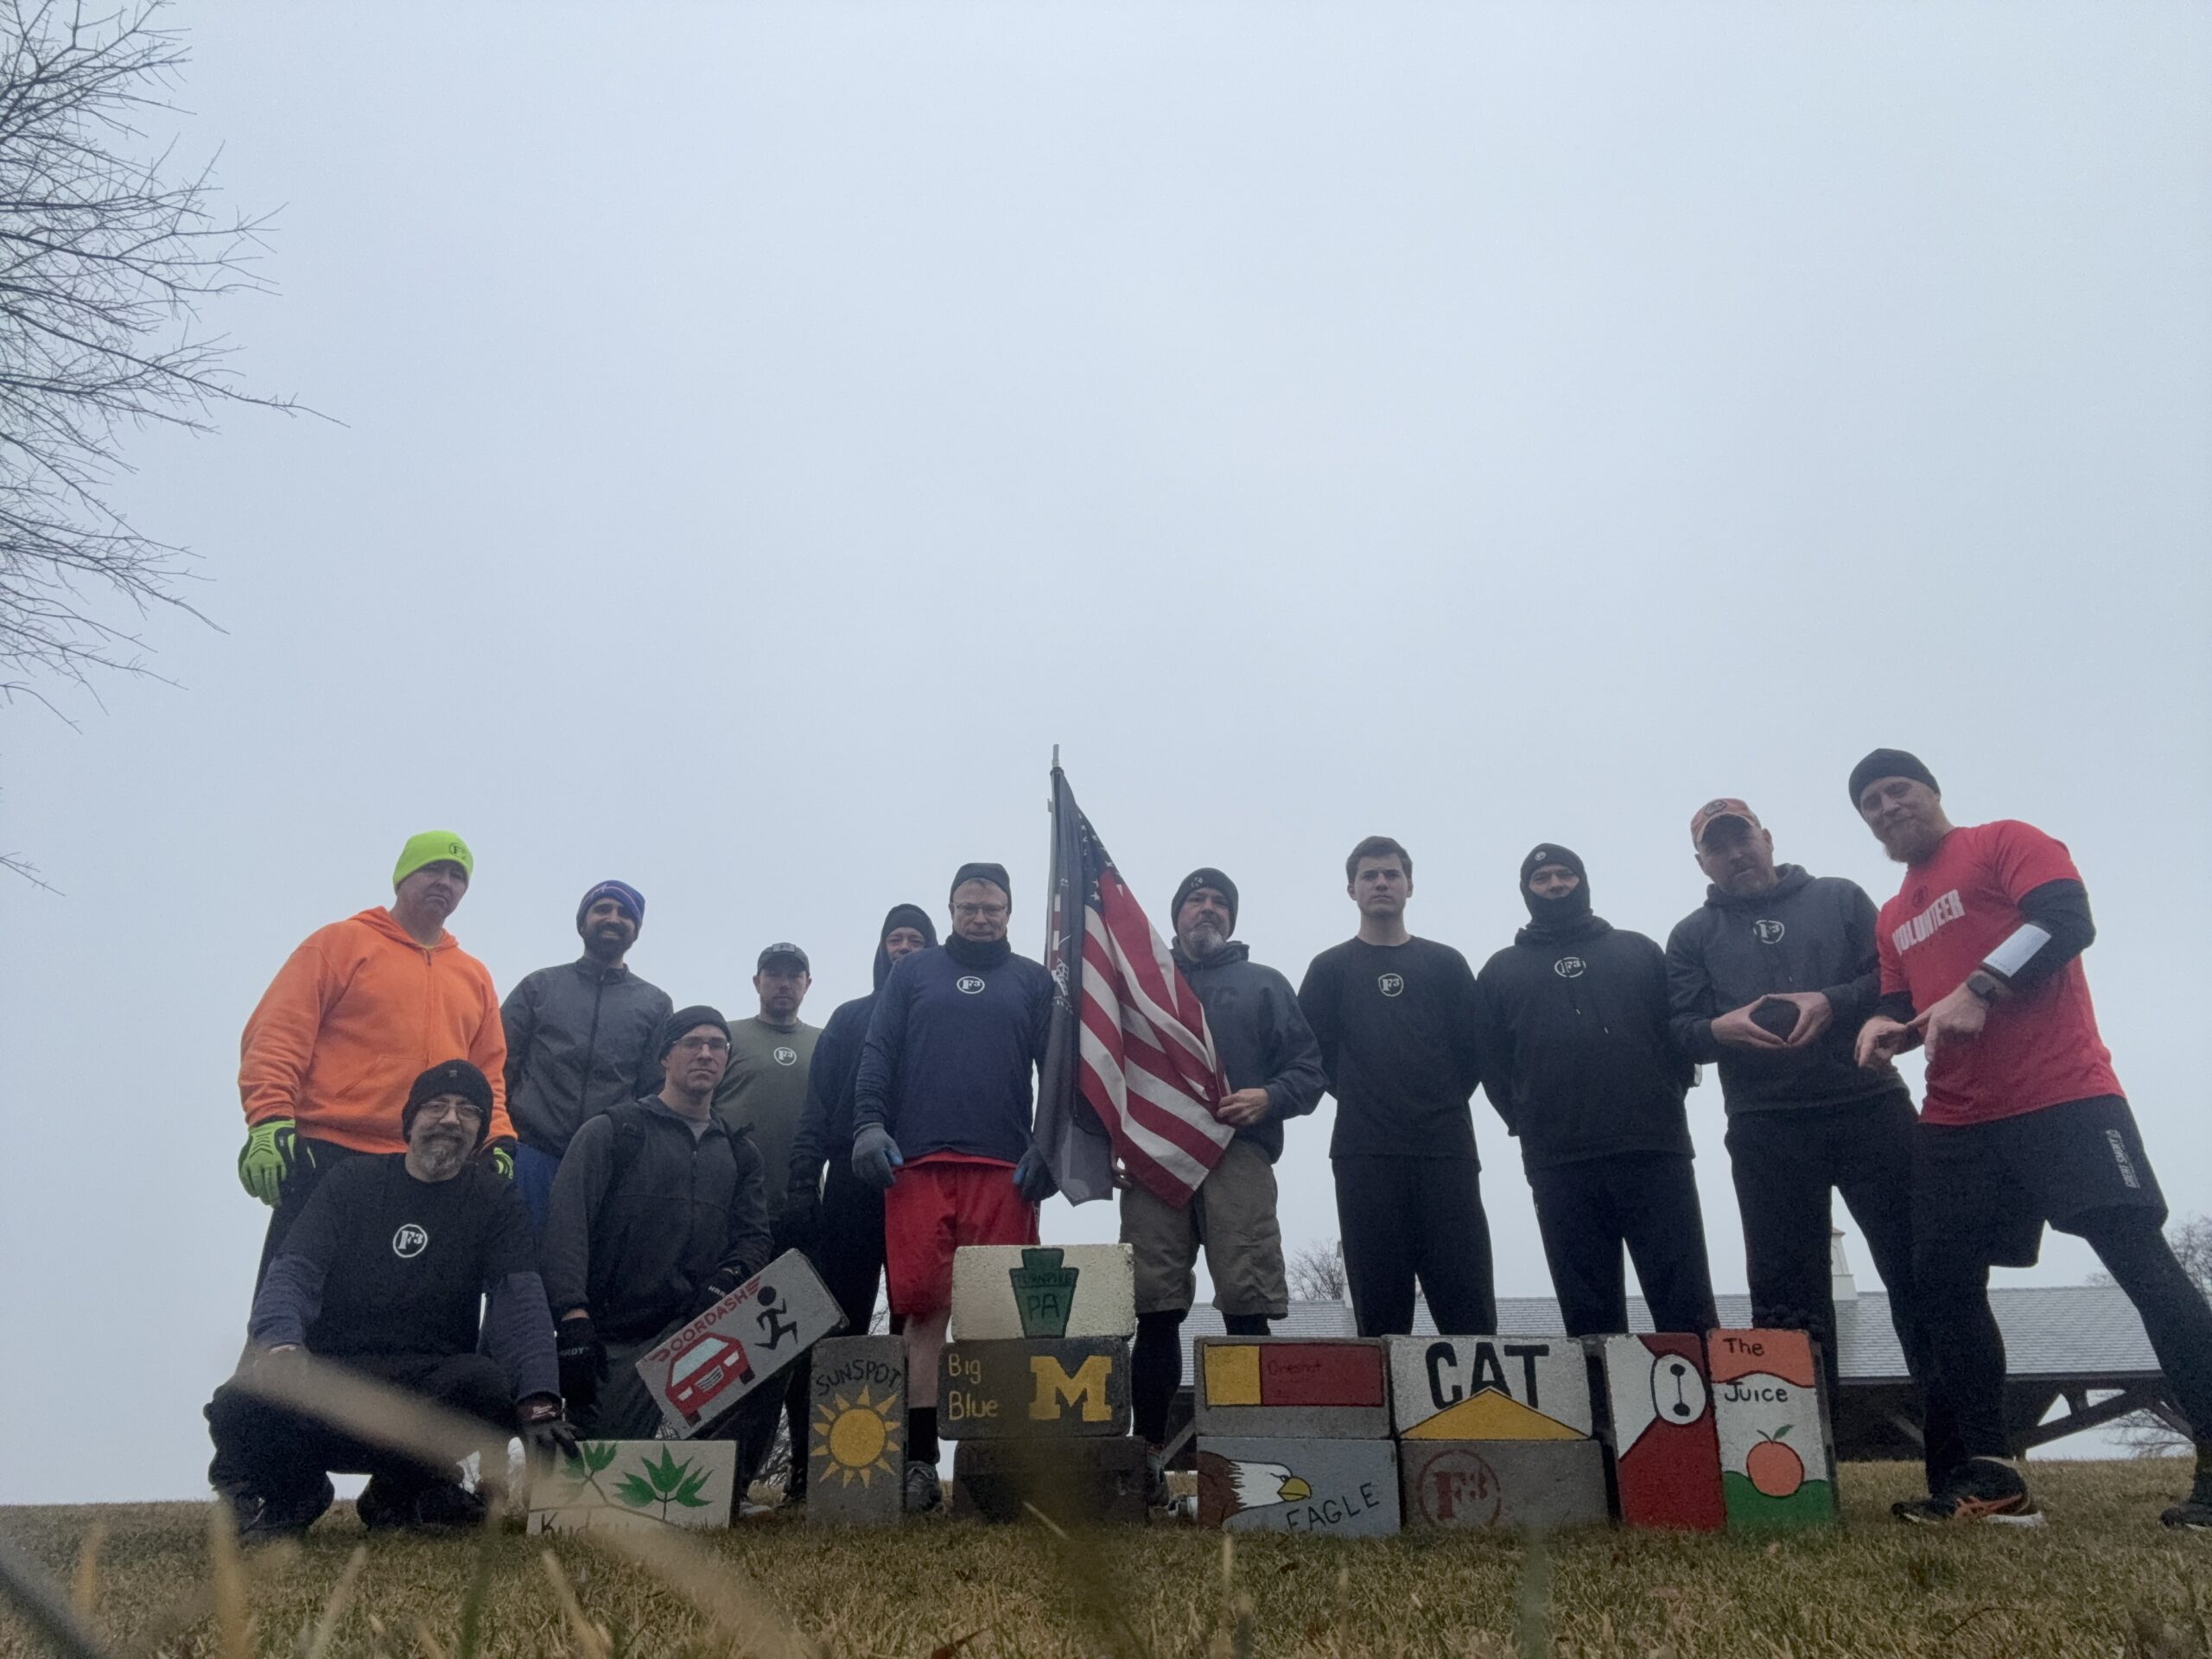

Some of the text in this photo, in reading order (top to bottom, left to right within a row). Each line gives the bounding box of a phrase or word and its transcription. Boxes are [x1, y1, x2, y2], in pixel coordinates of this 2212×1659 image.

[1892, 889, 1966, 957] VOLUNTEER
[650, 1287, 750, 1363] DOORDASH
[1027, 1293, 1060, 1321] PA
[1722, 1338, 1764, 1357] The
[816, 1359, 901, 1396] SUNSPOT
[948, 1354, 982, 1384] Big
[1426, 1342, 1550, 1410] CAT
[949, 1390, 999, 1421] Blue
[1029, 1355, 1113, 1422] M
[1725, 1382, 1789, 1402] Juice
[1286, 1482, 1380, 1531] EAGLE
